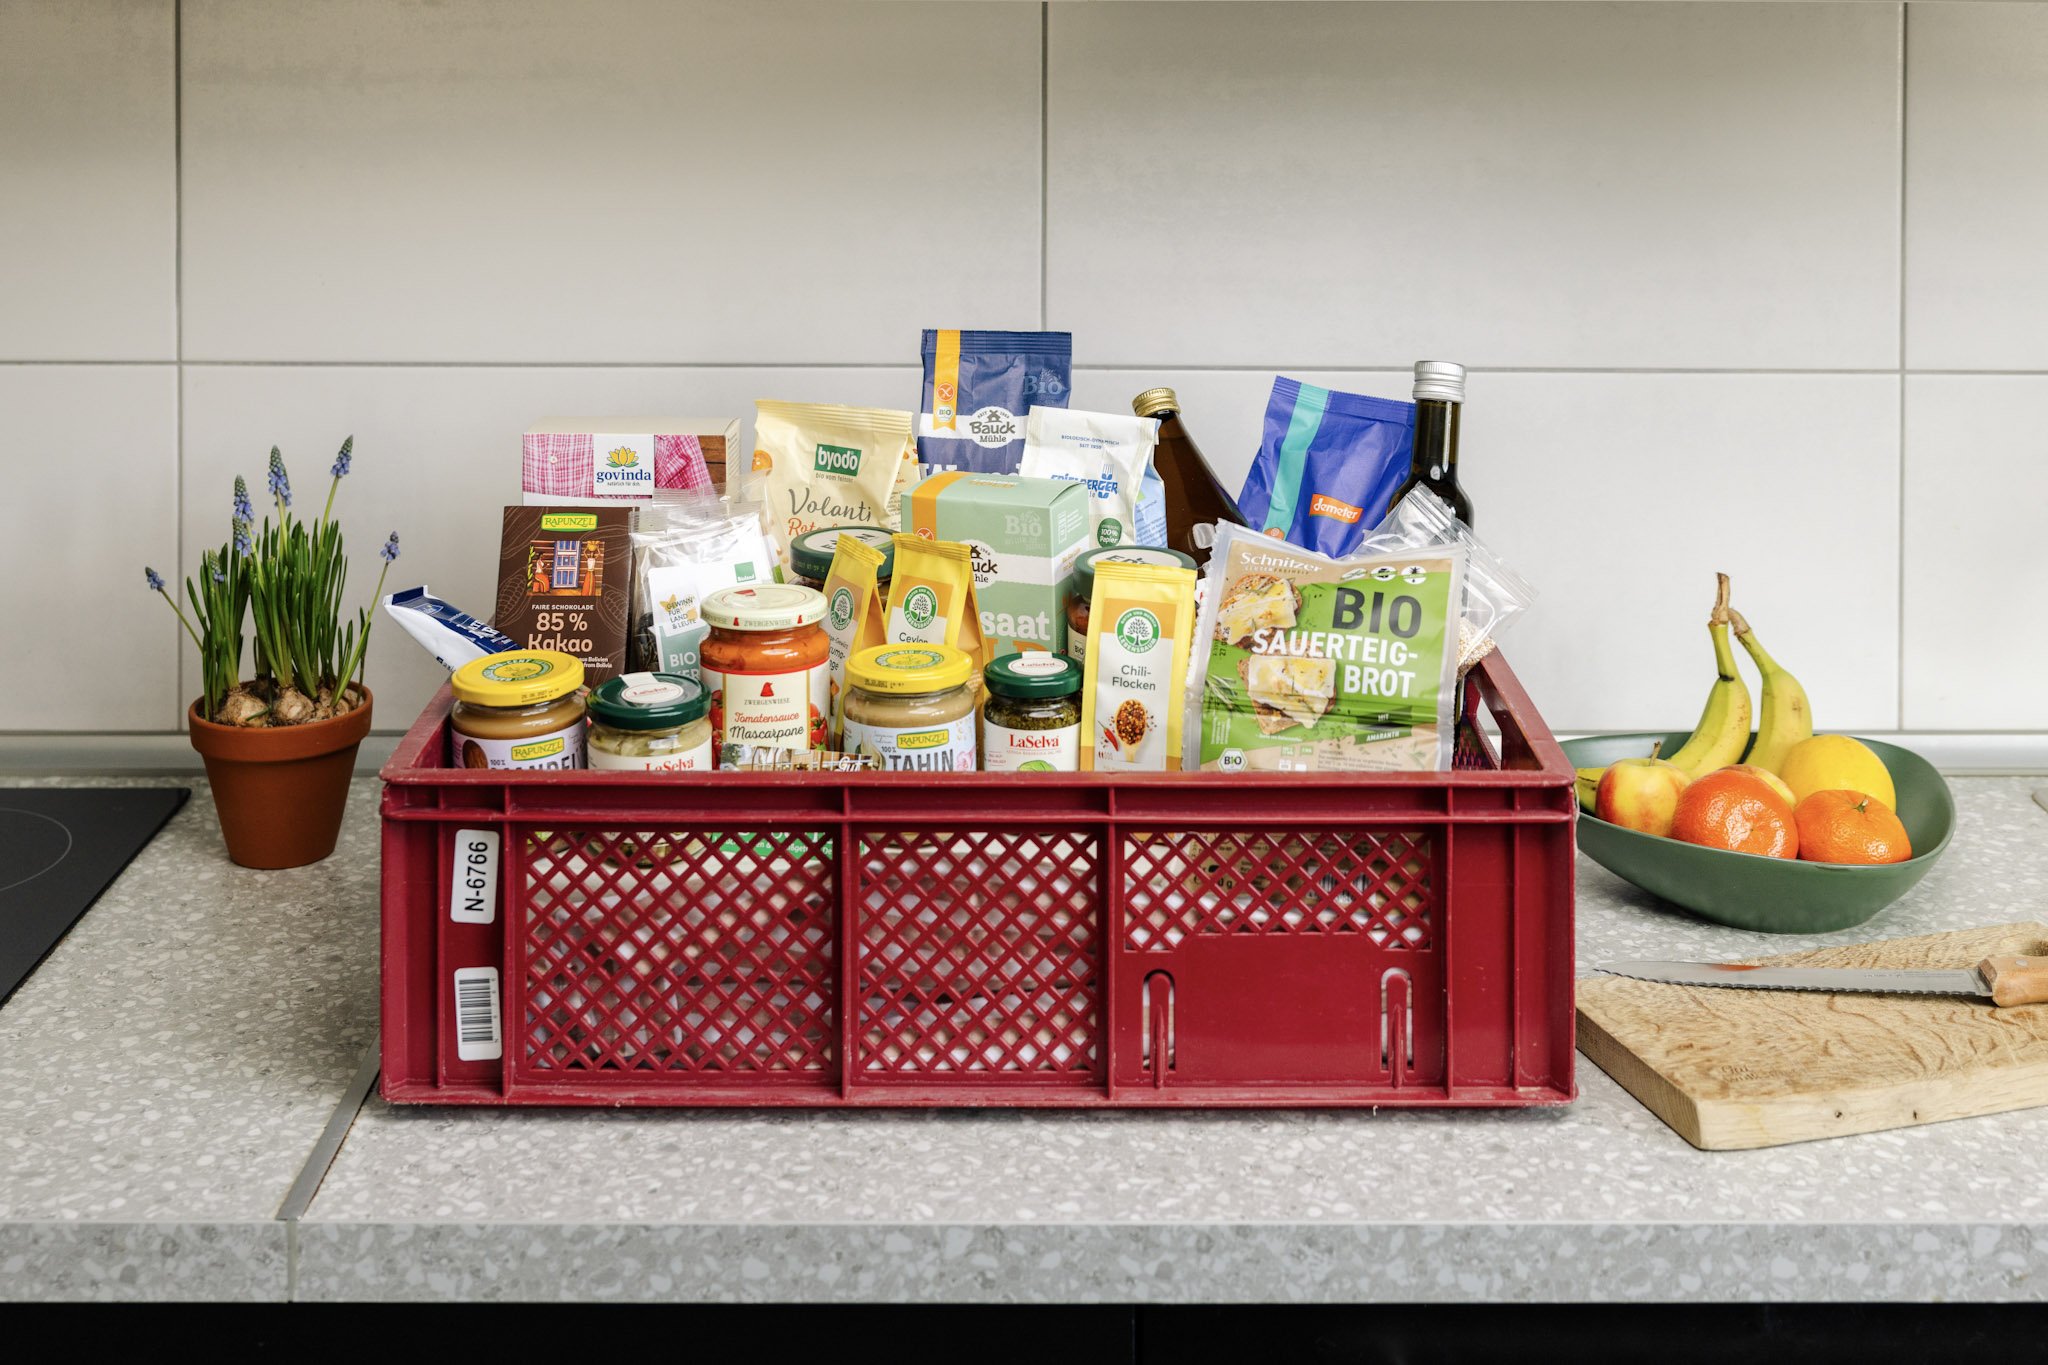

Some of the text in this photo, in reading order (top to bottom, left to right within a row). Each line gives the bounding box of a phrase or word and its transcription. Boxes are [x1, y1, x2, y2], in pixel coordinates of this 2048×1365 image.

[969, 421, 1016, 435] Bauck
[979, 434, 1007, 443] Mühle
[818, 446, 858, 471] byodo
[596, 469, 652, 483] govinda
[788, 487, 872, 522] Volanti
[1313, 498, 1359, 519] demeter
[544, 517, 595, 528] RAPUNZEL
[971, 560, 998, 575] uck
[1240, 551, 1322, 572] Schnitzer
[974, 574, 989, 583] hle
[670, 613, 688, 623] LAND
[1331, 586, 1422, 639] BIO
[536, 612, 565, 632] 85
[569, 612, 588, 632] %
[528, 633, 593, 653] Kakao
[1251, 628, 1418, 666] SAUERTEIG-
[669, 651, 697, 667] BIO
[1121, 664, 1152, 677] Chili-
[1112, 676, 1156, 691] Flocken
[1343, 664, 1416, 698] BROT
[743, 697, 791, 706] ZWERGENWIESE
[734, 711, 800, 724] Tomatensauce
[729, 724, 805, 743] Mascarpone
[899, 733, 947, 747] RAPUNZEL
[1009, 733, 1059, 749] LaSelva
[514, 742, 562, 759] RAPUNZEL
[888, 749, 954, 772] TAHIN
[1223, 756, 1242, 766] BIO
[464, 841, 488, 912] N-6766
